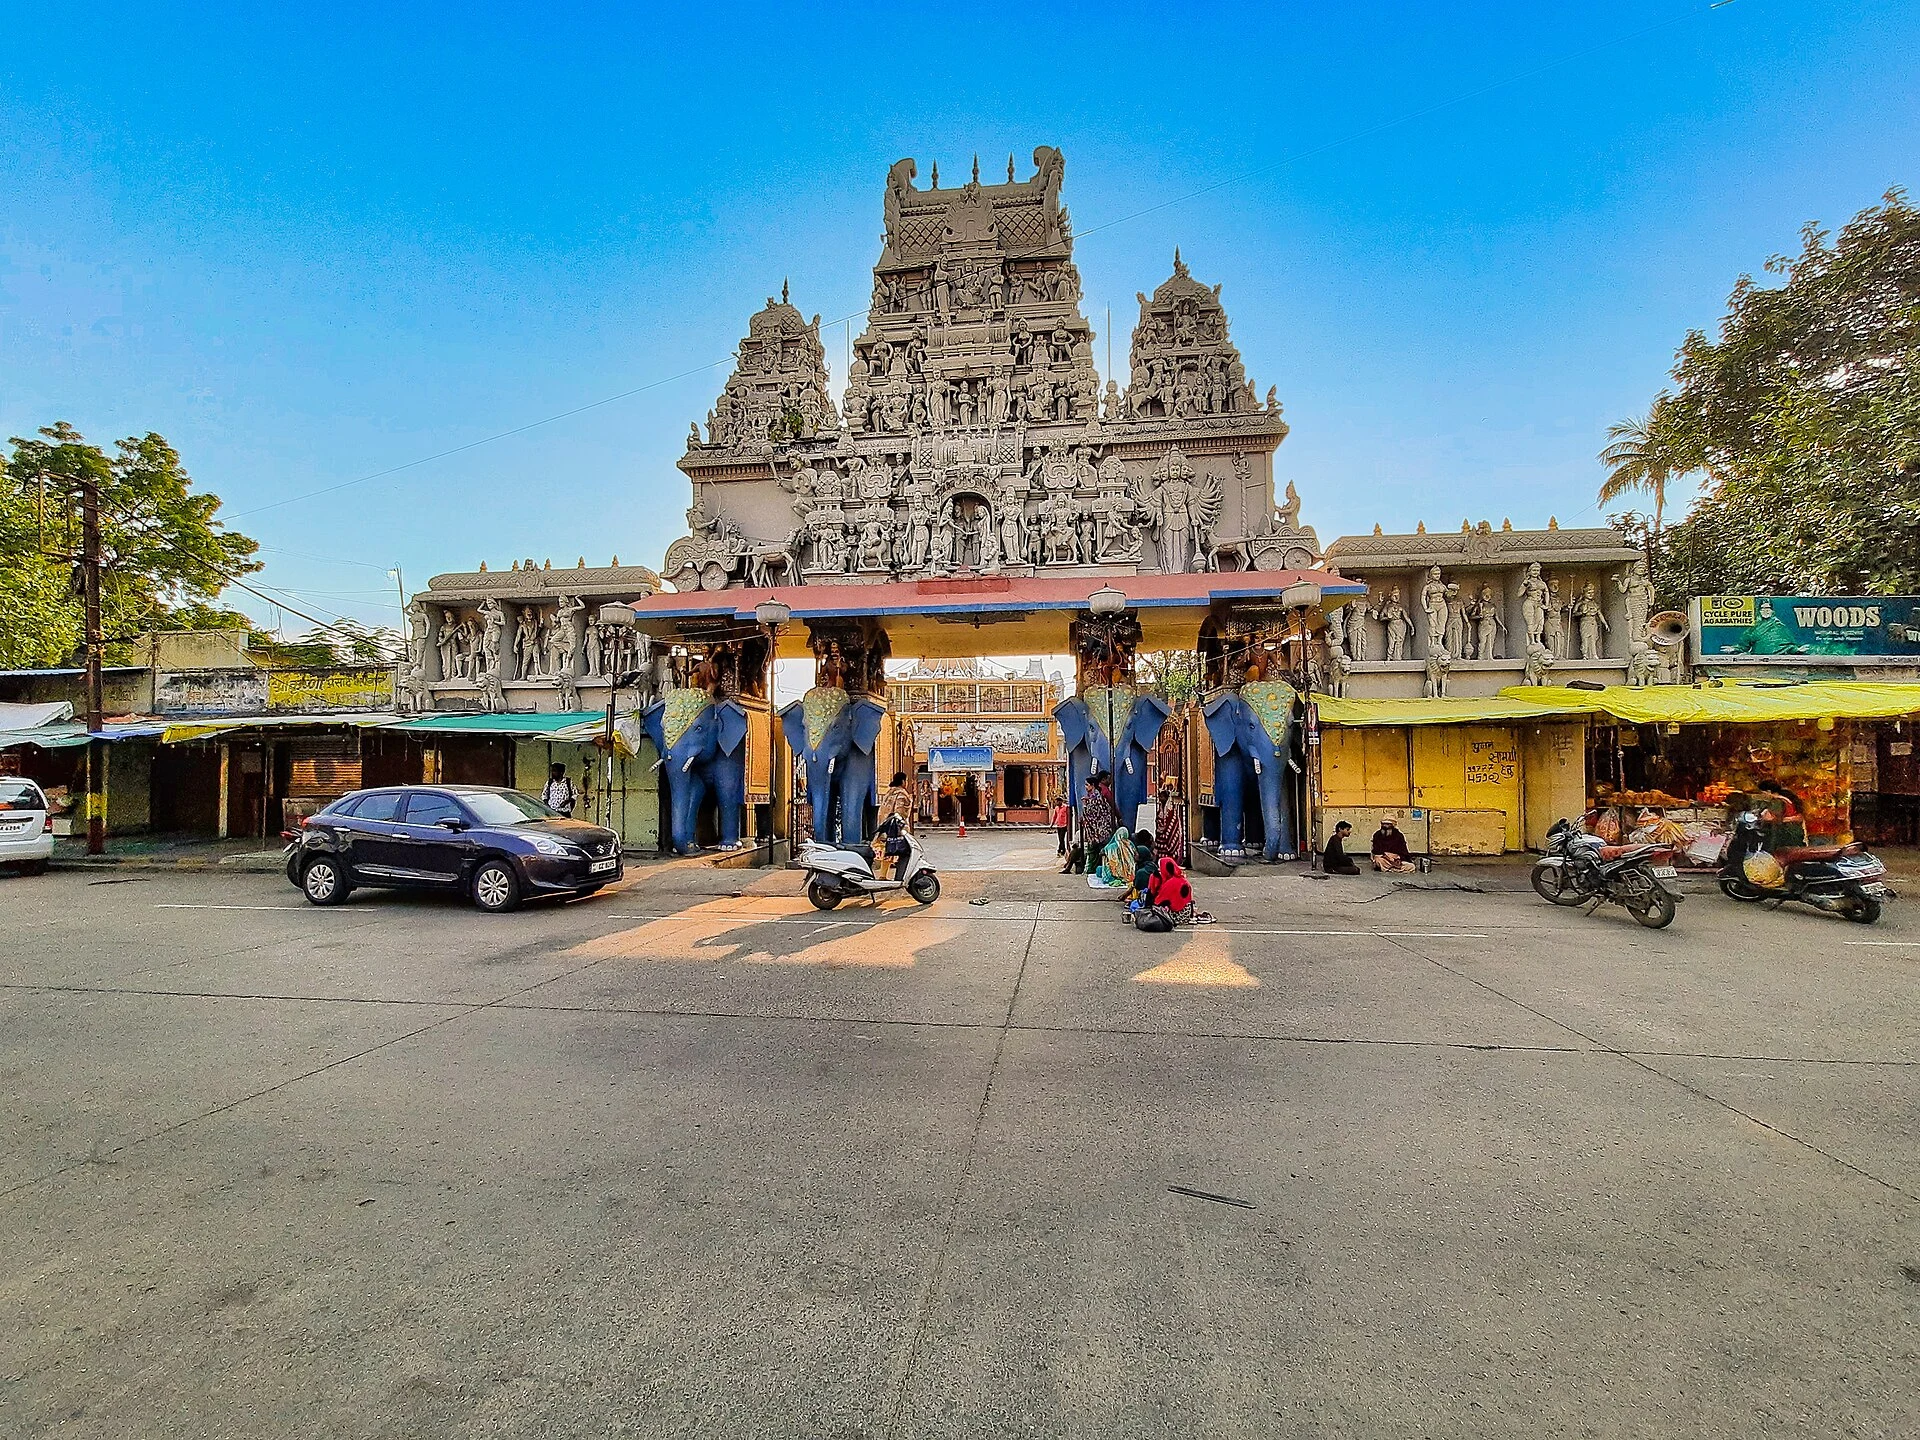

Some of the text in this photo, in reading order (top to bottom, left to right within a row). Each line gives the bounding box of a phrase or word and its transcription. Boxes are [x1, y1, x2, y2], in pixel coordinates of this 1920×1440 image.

[1703, 610, 1753, 618] CYCLE PURE
[1794, 607, 1881, 628] WOODS
